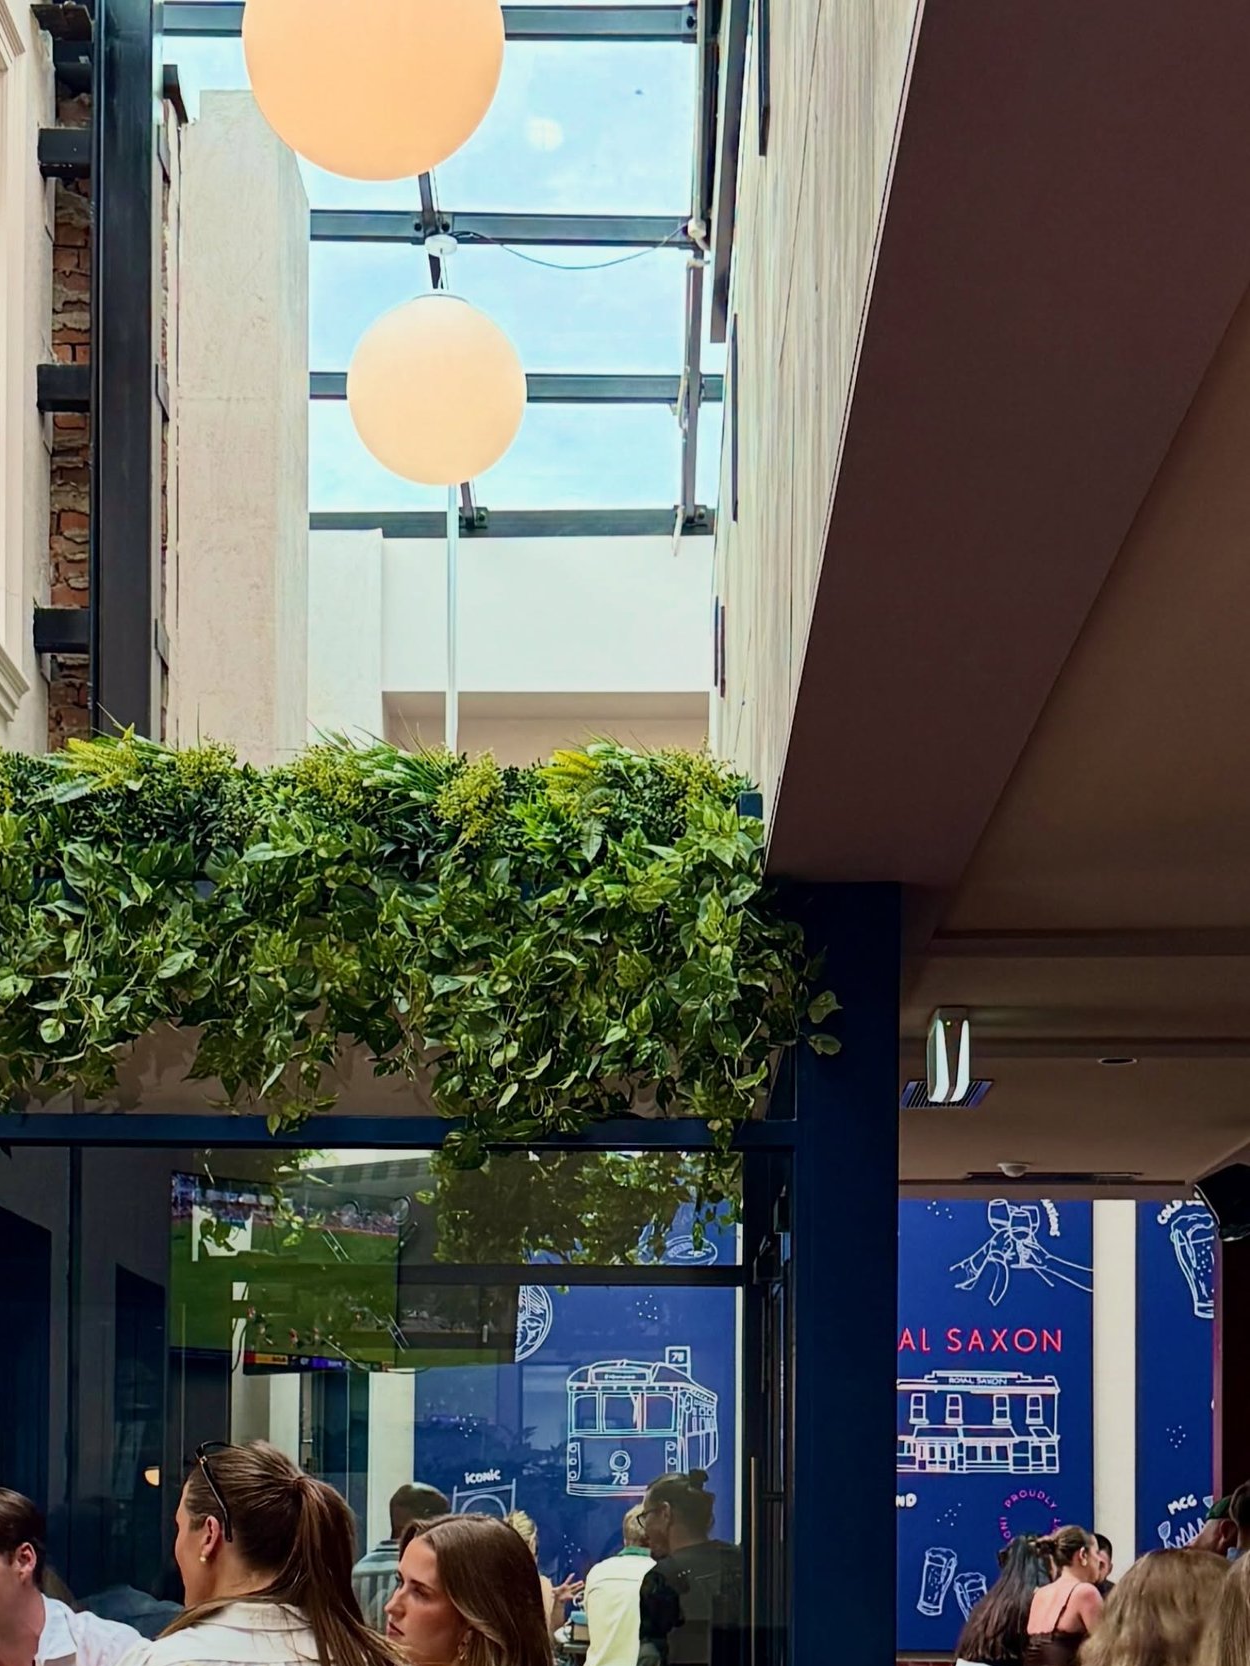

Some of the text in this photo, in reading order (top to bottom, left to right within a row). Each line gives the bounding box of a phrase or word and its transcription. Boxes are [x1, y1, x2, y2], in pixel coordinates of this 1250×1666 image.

[947, 1328, 1062, 1352] SAXON
[611, 1471, 629, 1485] 78
[1004, 1489, 1057, 1508] PROUDLY
